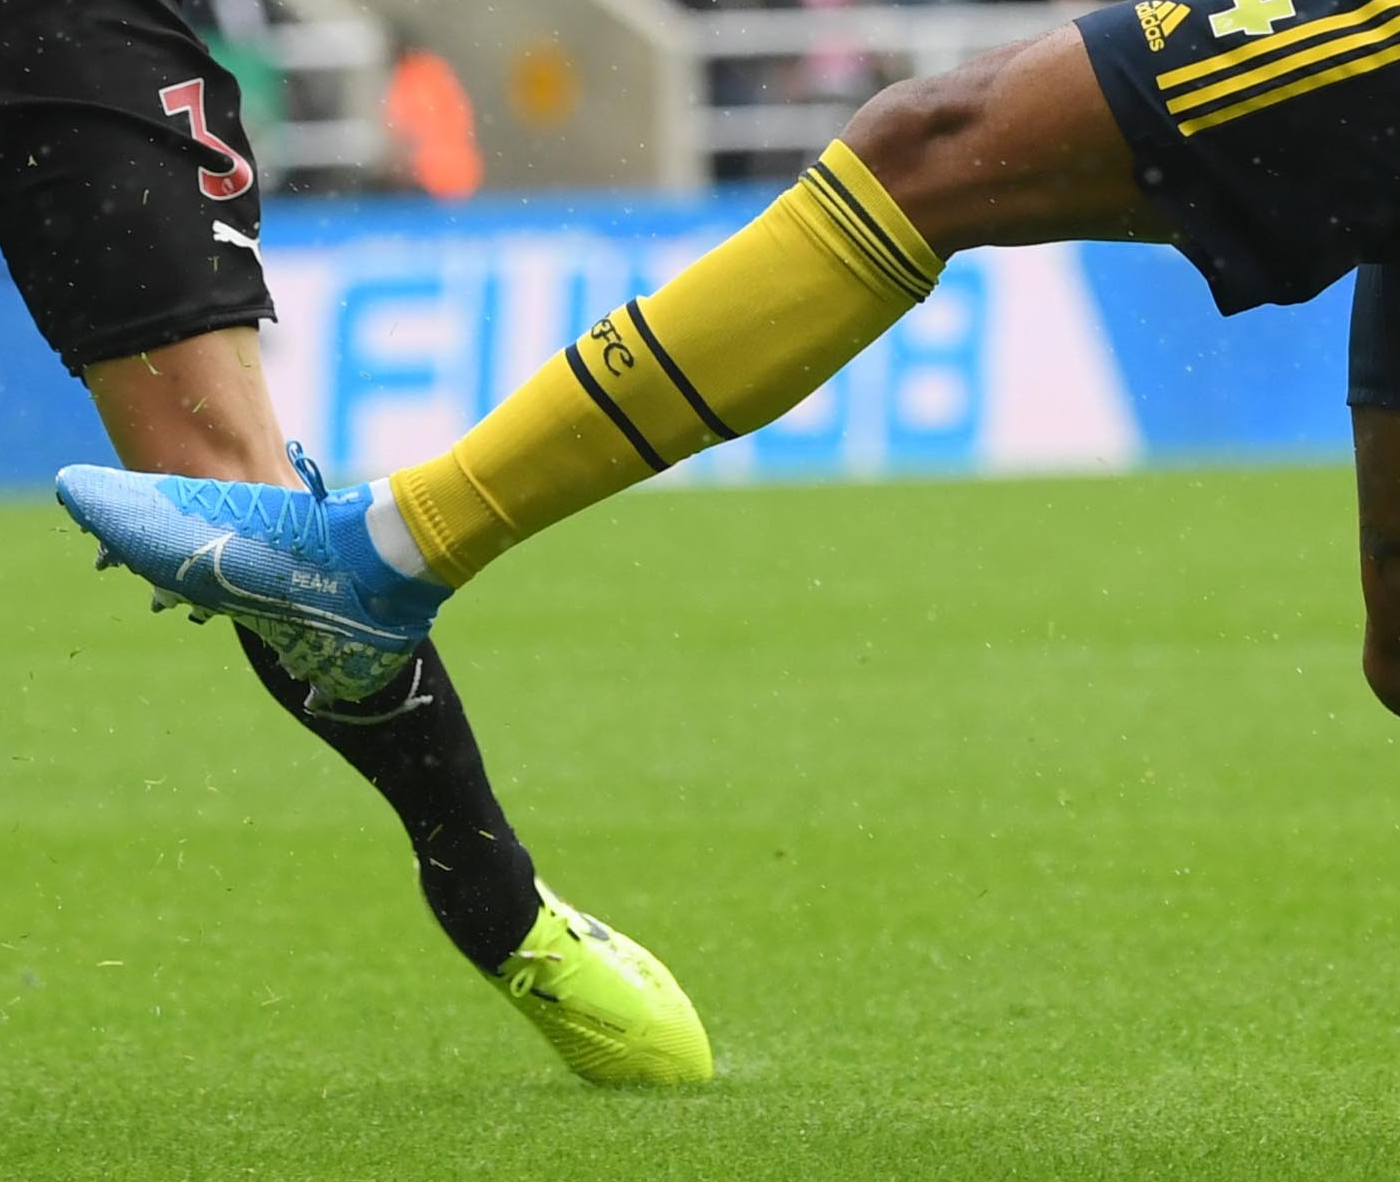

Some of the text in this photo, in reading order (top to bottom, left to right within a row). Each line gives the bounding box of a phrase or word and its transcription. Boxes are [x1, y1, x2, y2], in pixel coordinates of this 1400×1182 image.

[1134, 0, 1166, 53] adidas
[158, 77, 255, 202] 3
[590, 312, 635, 377] FC
